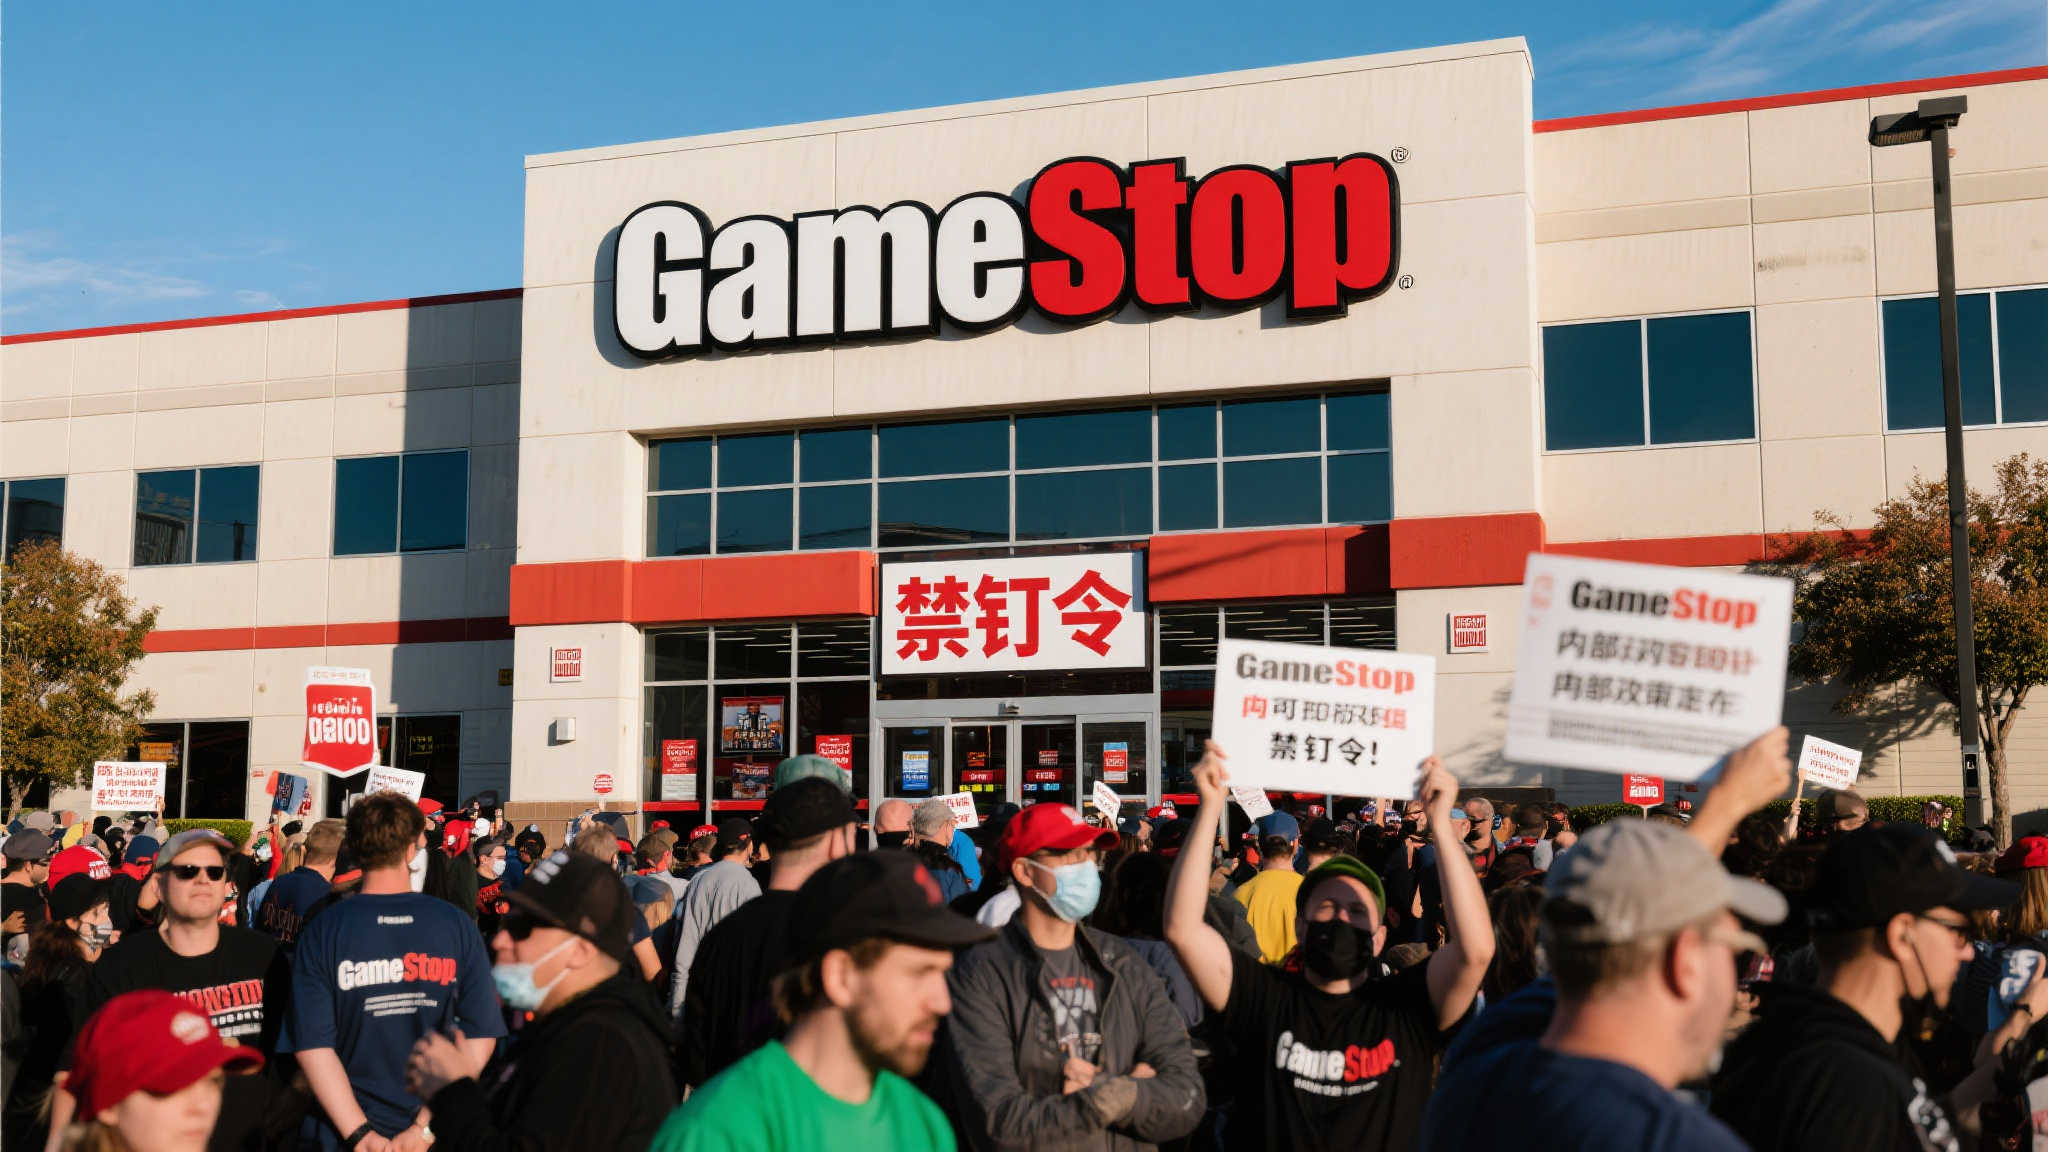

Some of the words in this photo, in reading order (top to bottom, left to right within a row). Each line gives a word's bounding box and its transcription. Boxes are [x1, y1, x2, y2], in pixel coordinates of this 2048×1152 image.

[613, 152, 1400, 357] GameStop
[896, 569, 1132, 662] 禁钉令
[1571, 580, 1758, 629] GameStop
[1236, 652, 1415, 695] GameStop
[338, 952, 457, 991] GameStop
